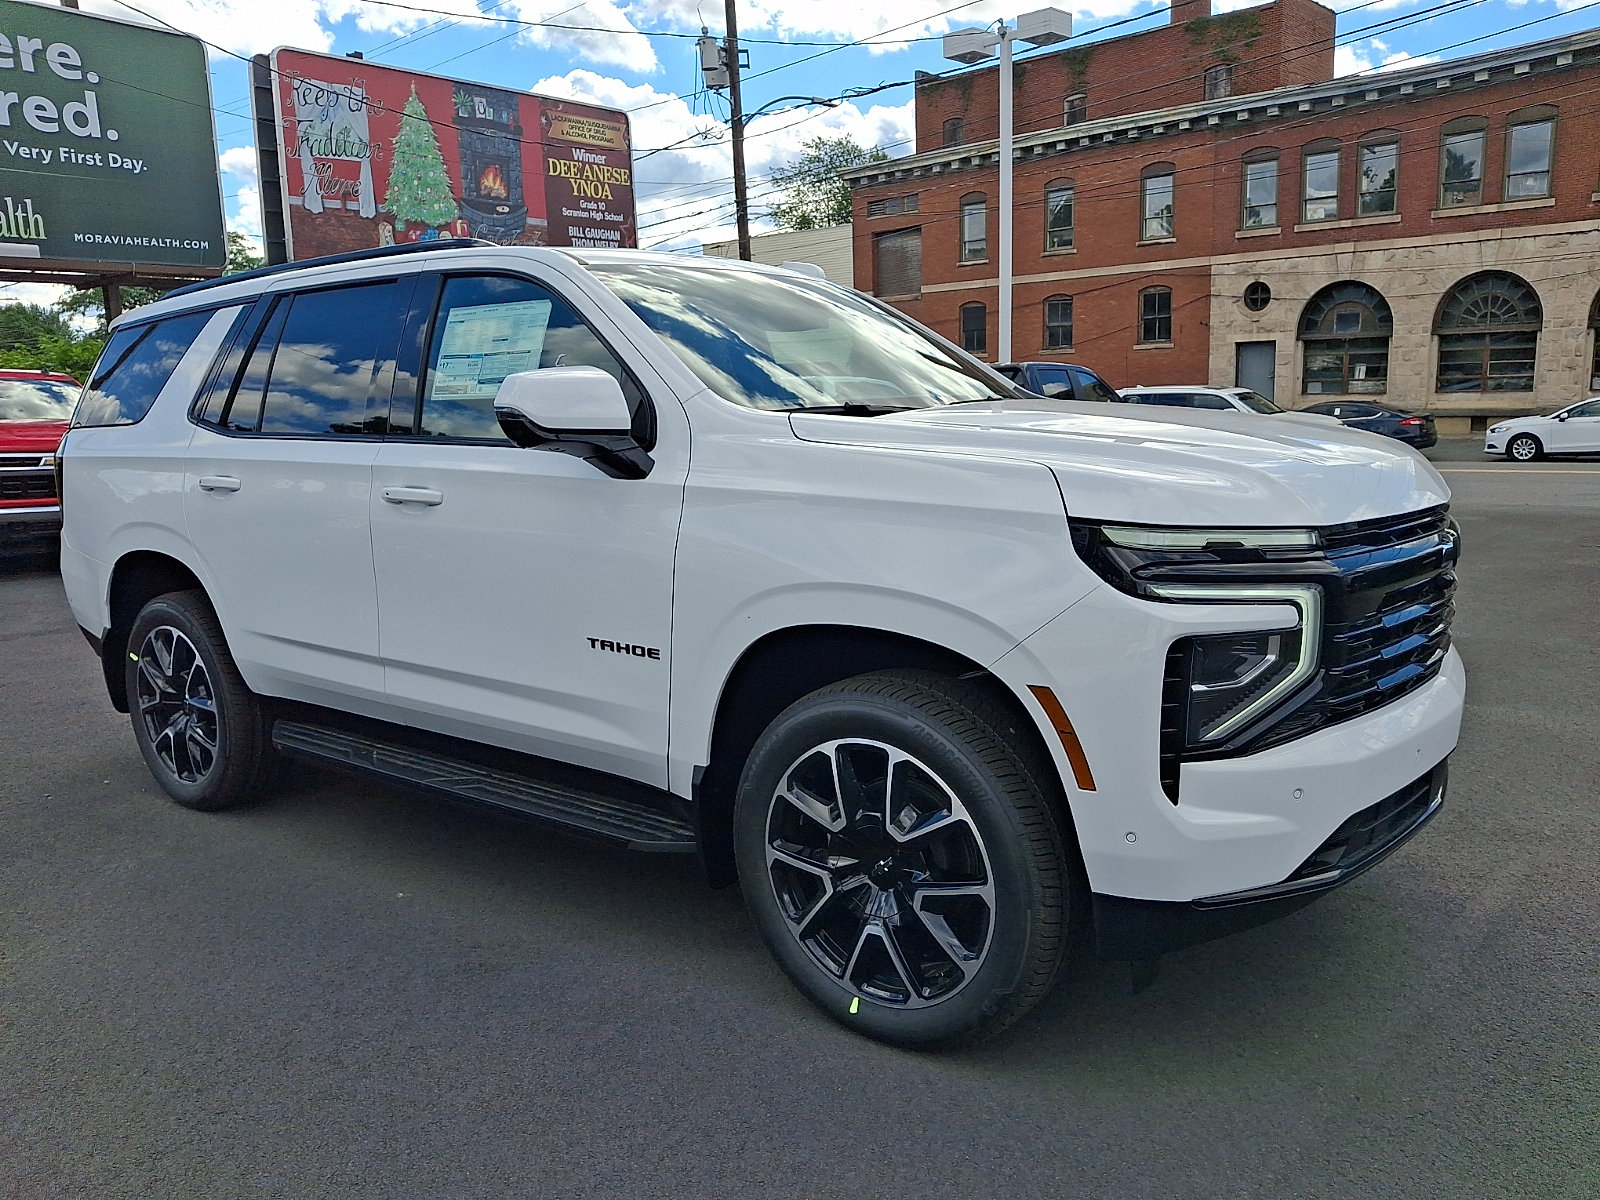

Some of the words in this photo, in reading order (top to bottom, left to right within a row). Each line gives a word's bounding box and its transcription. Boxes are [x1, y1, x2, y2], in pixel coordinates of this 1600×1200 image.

[284, 69, 340, 121] Keep
[282, 116, 384, 161] Tradition
[566, 130, 588, 139] ALCOHOL
[589, 134, 615, 144] PROGRAMS
[568, 124, 585, 133] OFFICE
[594, 128, 606, 136] DRUG
[3, 140, 52, 164] Very
[60, 147, 103, 167] First
[108, 153, 148, 173] Day.
[572, 148, 607, 165] Winner
[570, 178, 613, 200] YNOA
[580, 200, 597, 209] Grade
[598, 201, 606, 210] 10
[562, 207, 589, 218] Scranton
[590, 210, 603, 221] High
[604, 211, 624, 221] School
[74, 233, 209, 249] MORAVIAHEALTH.COM
[568, 225, 585, 237] BILL
[585, 227, 621, 240] GAUGHAN
[586, 637, 661, 660] TAHOE
[912, 723, 994, 807] BRIDGESTONE
